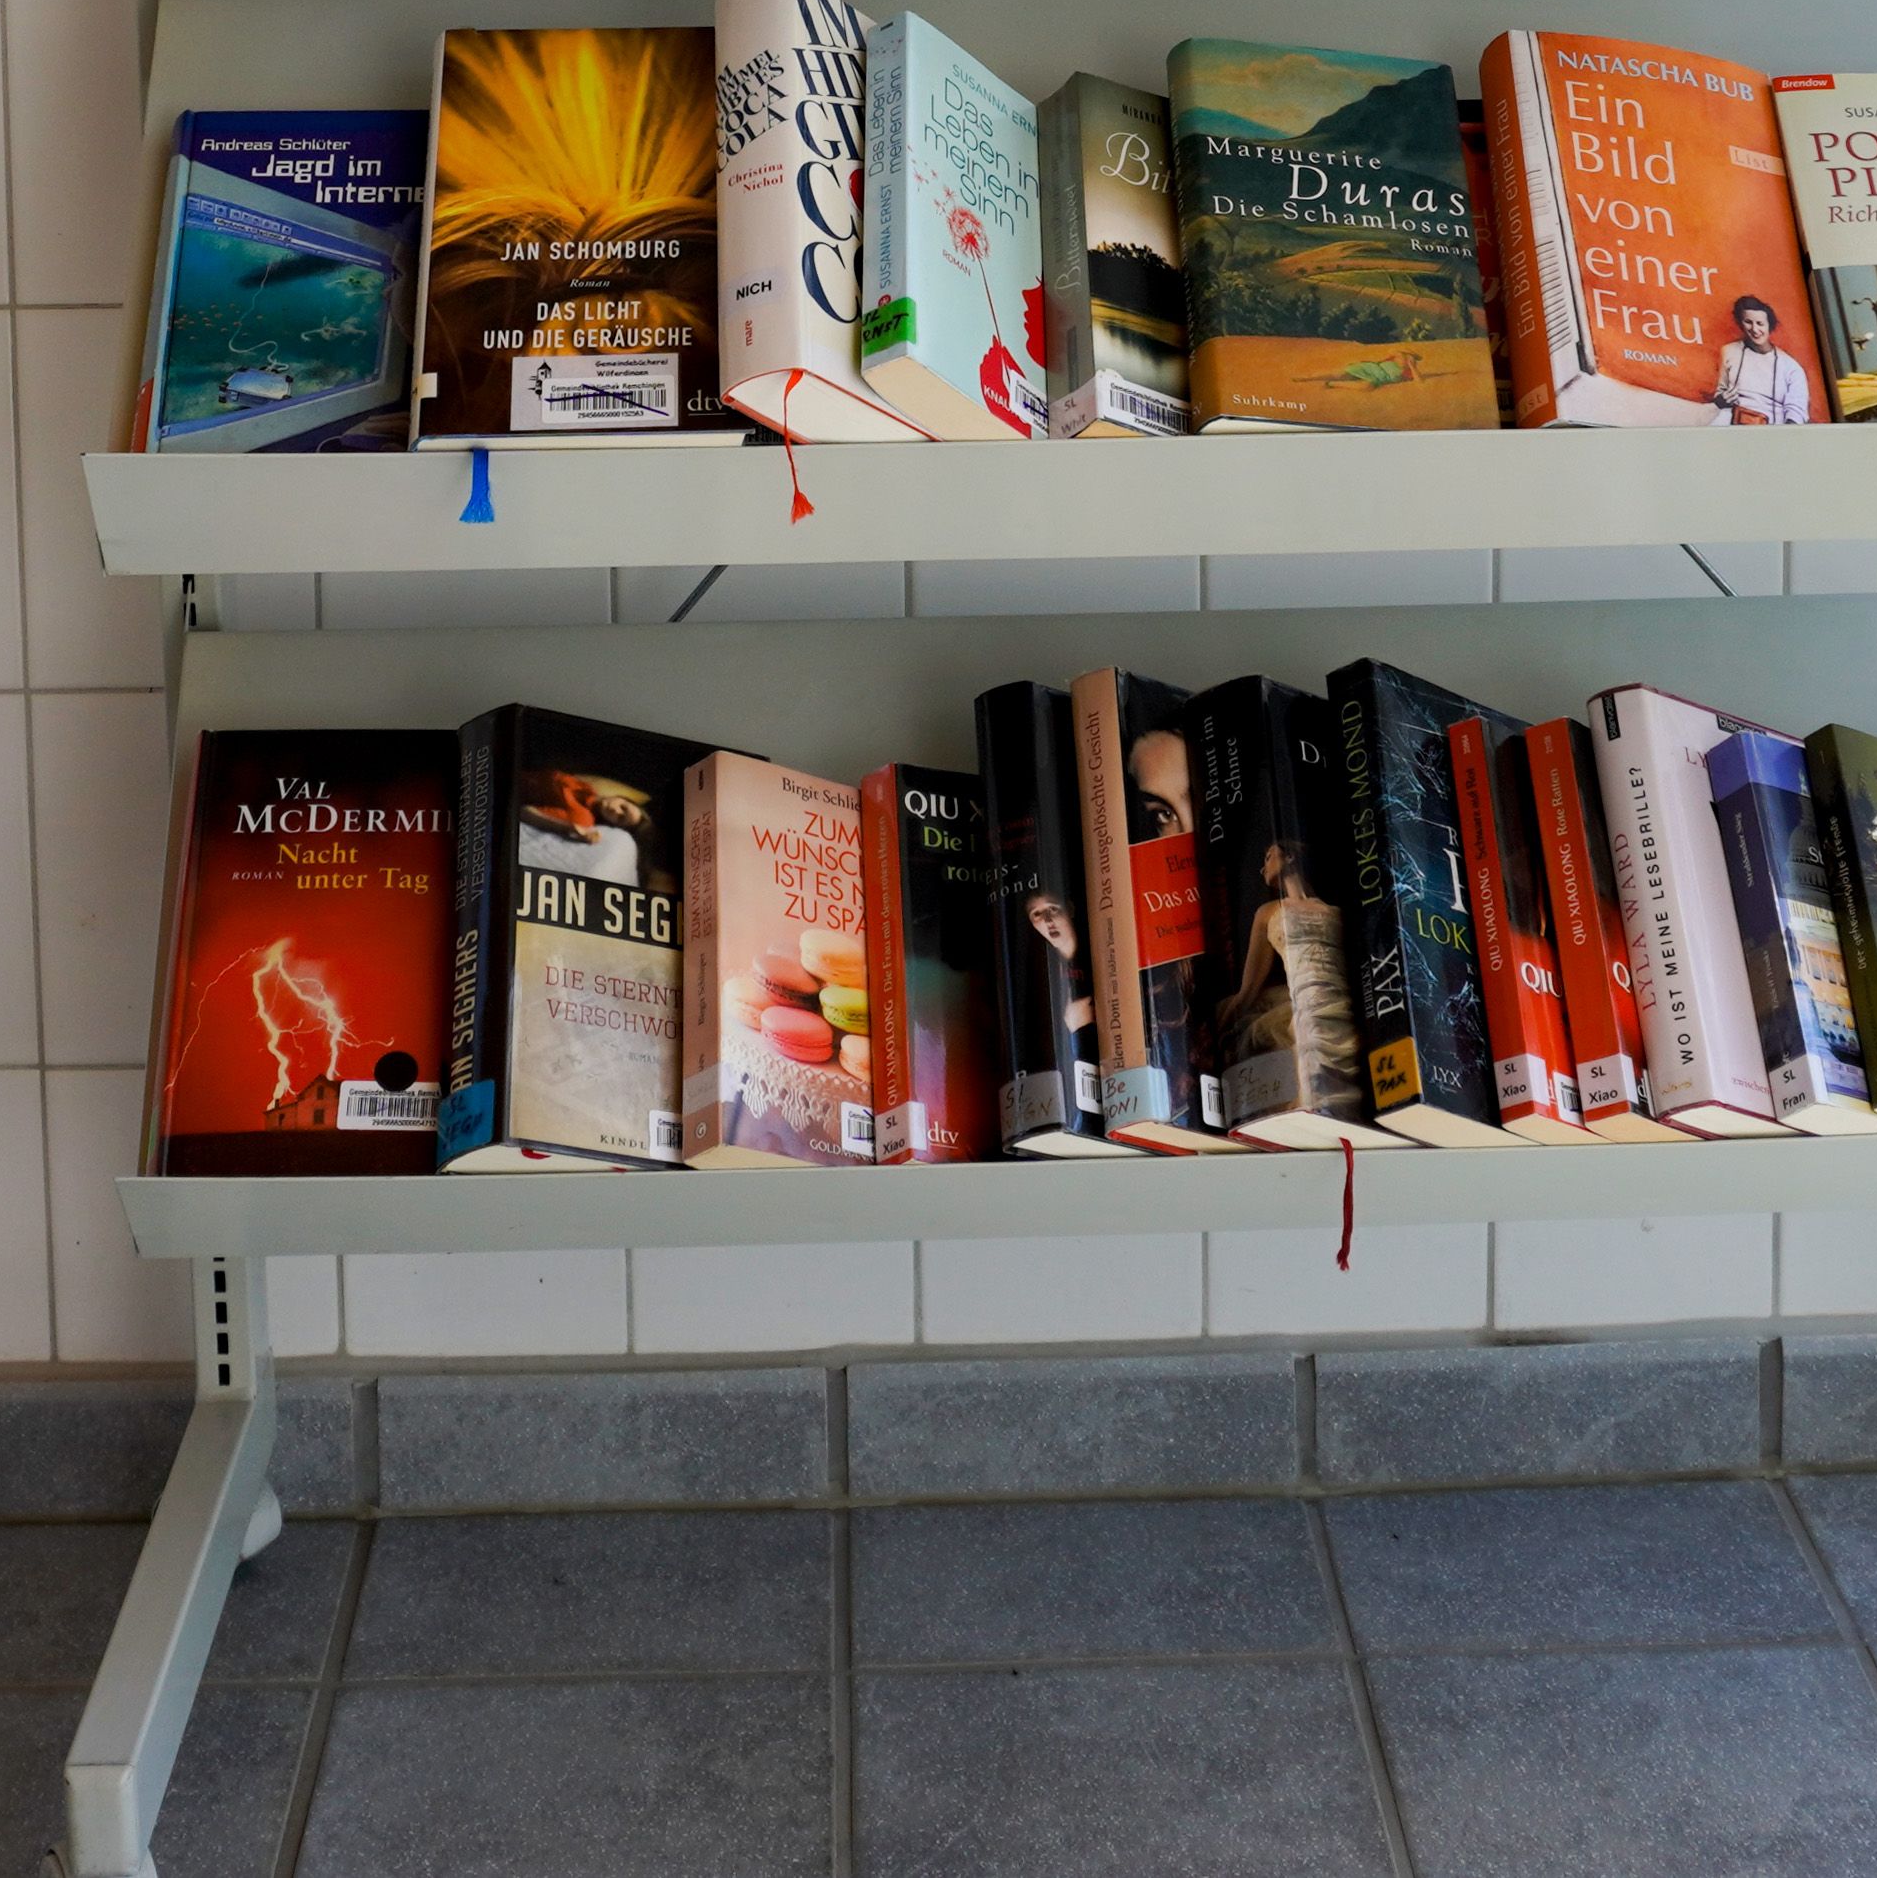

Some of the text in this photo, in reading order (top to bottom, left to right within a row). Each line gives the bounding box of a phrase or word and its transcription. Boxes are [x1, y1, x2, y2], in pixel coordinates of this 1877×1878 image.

[1558, 49, 1753, 103] NATASCHA BUB
[1565, 80, 1644, 129] Ein
[201, 137, 351, 153] Andreas Schlüter
[1206, 135, 1382, 171] Marguerite
[251, 155, 382, 184] Jagd im
[1575, 131, 1677, 184] Bild
[1289, 163, 1466, 218] Duras
[1212, 194, 1471, 239] Die Schamlosen
[1578, 192, 1675, 237] von
[500, 240, 680, 261] JAN SCHOMBURG
[1409, 239, 1473, 257] Roman
[1586, 242, 1719, 294] einer
[570, 279, 610, 289] Roman
[736, 280, 772, 301] NICH
[537, 300, 642, 321] DAS LICHT
[1594, 291, 1703, 345] Frau
[483, 325, 693, 349] UND DIE GERÄUSCHE
[1623, 347, 1678, 366] ROMAN
[1232, 393, 1307, 414] Suhrkamp
[781, 777, 820, 803] Birgit
[903, 789, 960, 821] QIU
[276, 843, 358, 866] Nacht
[296, 866, 429, 895] unter Tag
[1629, 767, 1694, 1066] WO IST MEINE LESEBRILLE?
[1432, 1064, 1462, 1088] LYX
[1590, 1066, 1606, 1078] SL
[1782, 1070, 1797, 1084] SL
[1588, 1088, 1619, 1102] Xiao
[1782, 1090, 1806, 1109] Fran
[927, 1123, 959, 1142] dtv
